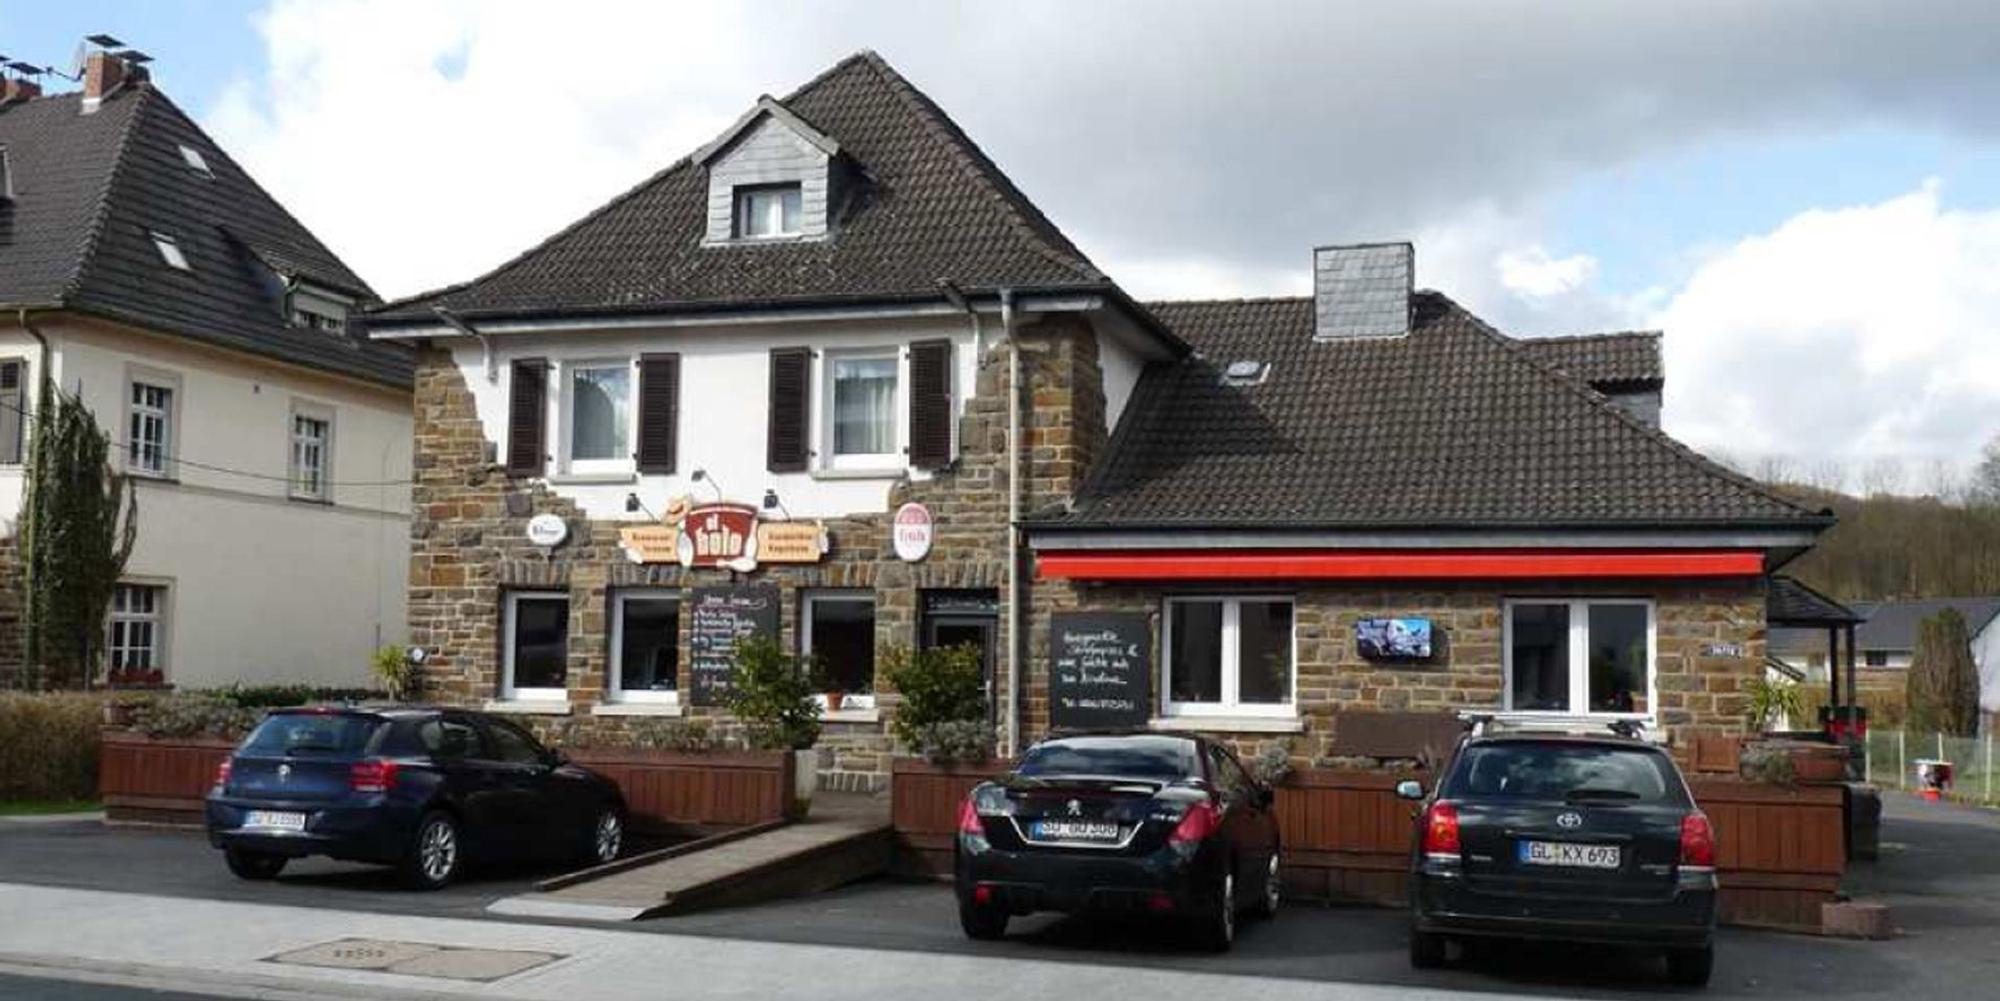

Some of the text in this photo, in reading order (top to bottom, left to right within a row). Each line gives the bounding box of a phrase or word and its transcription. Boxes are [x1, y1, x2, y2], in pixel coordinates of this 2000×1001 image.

[695, 524, 743, 556] bolo
[1531, 840, 1618, 864] GL KX 693
